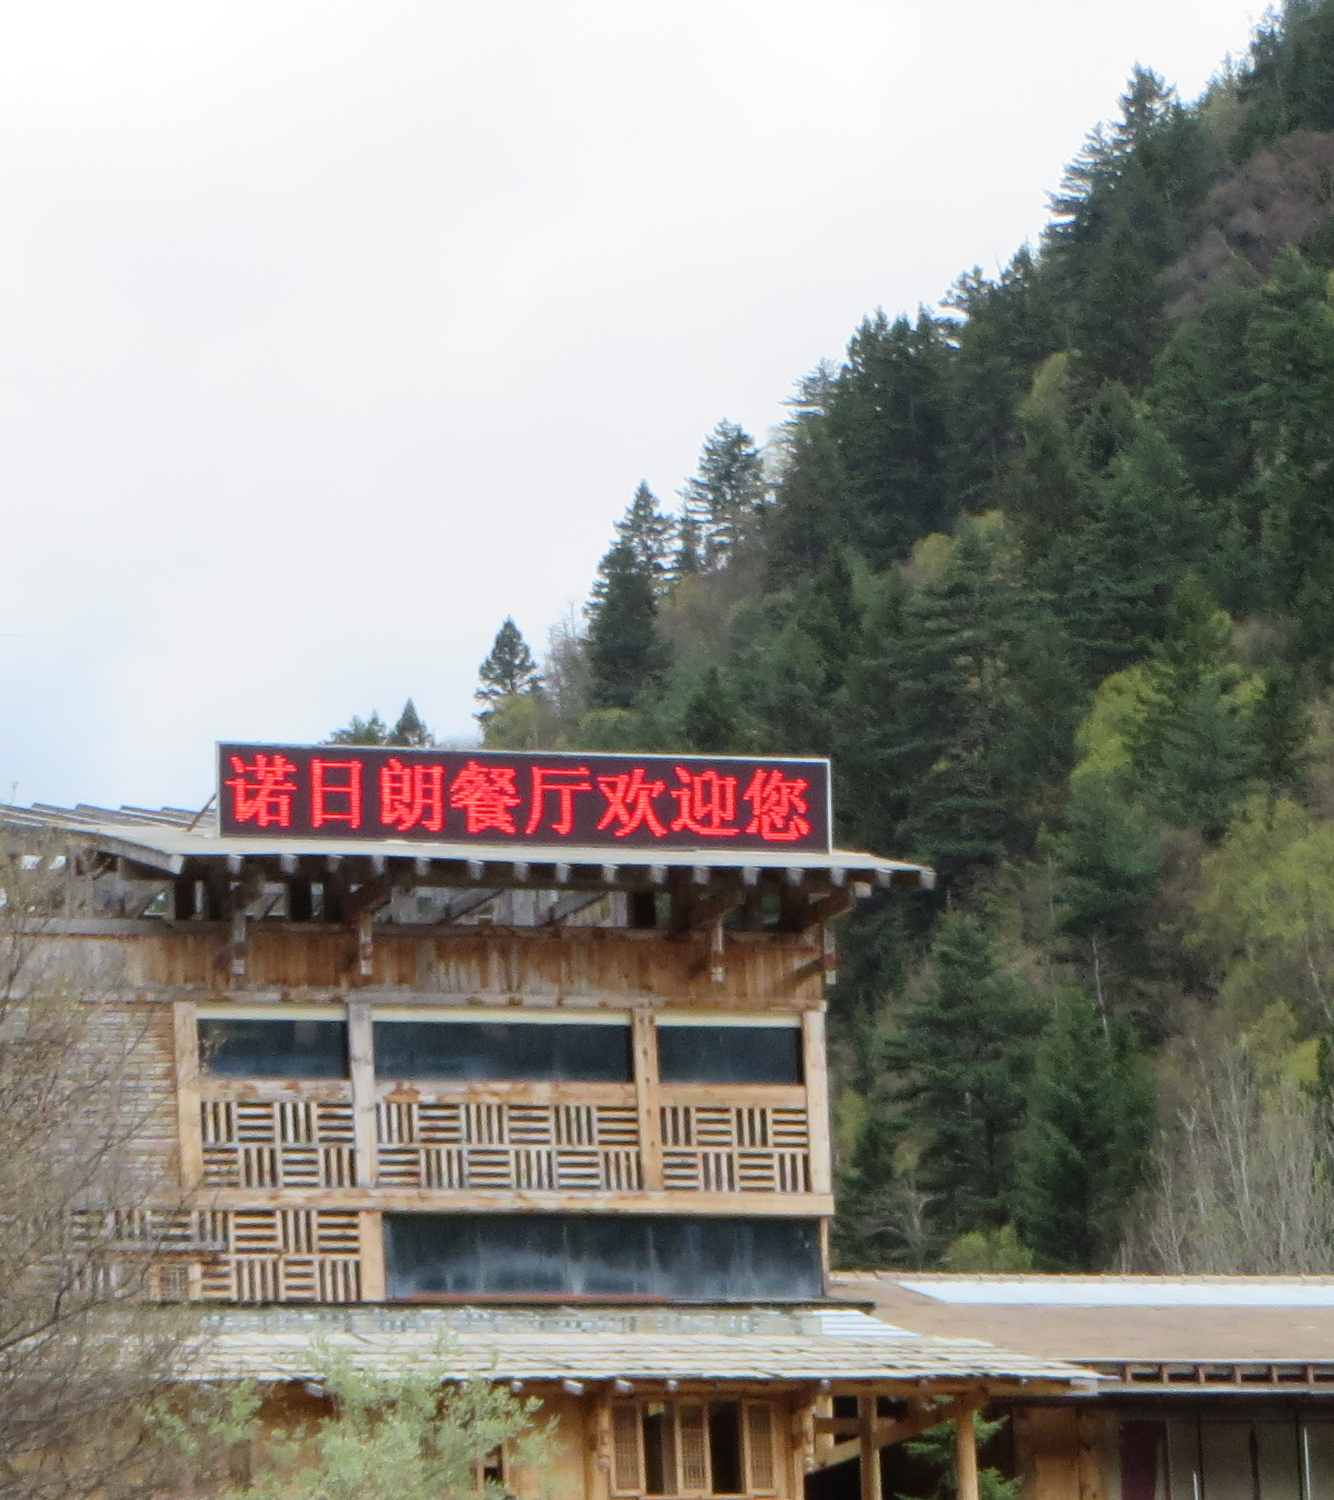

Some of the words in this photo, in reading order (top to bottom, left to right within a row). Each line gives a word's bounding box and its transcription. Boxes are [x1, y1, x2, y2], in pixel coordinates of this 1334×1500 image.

[225, 755, 810, 841] 诺日朗餐厅欢迎您
